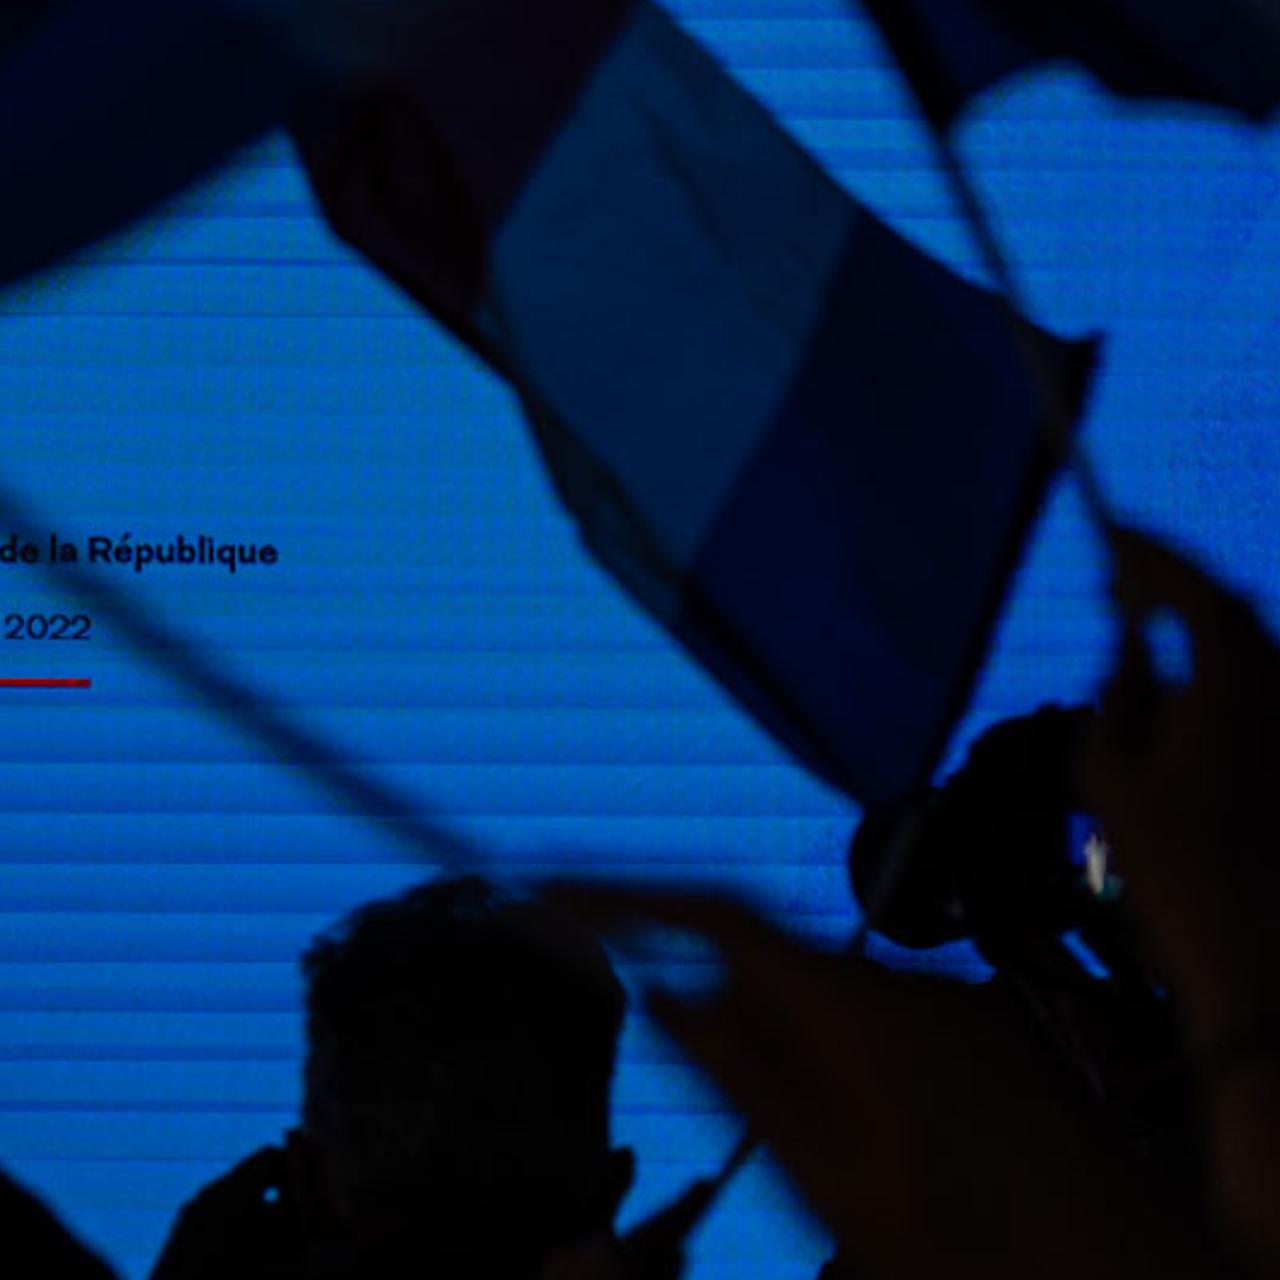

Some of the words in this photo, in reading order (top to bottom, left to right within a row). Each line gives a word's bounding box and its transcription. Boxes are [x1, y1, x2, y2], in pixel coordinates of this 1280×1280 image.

[49, 532, 79, 564] la
[87, 531, 279, 575] République
[4, 612, 93, 641] 2022
